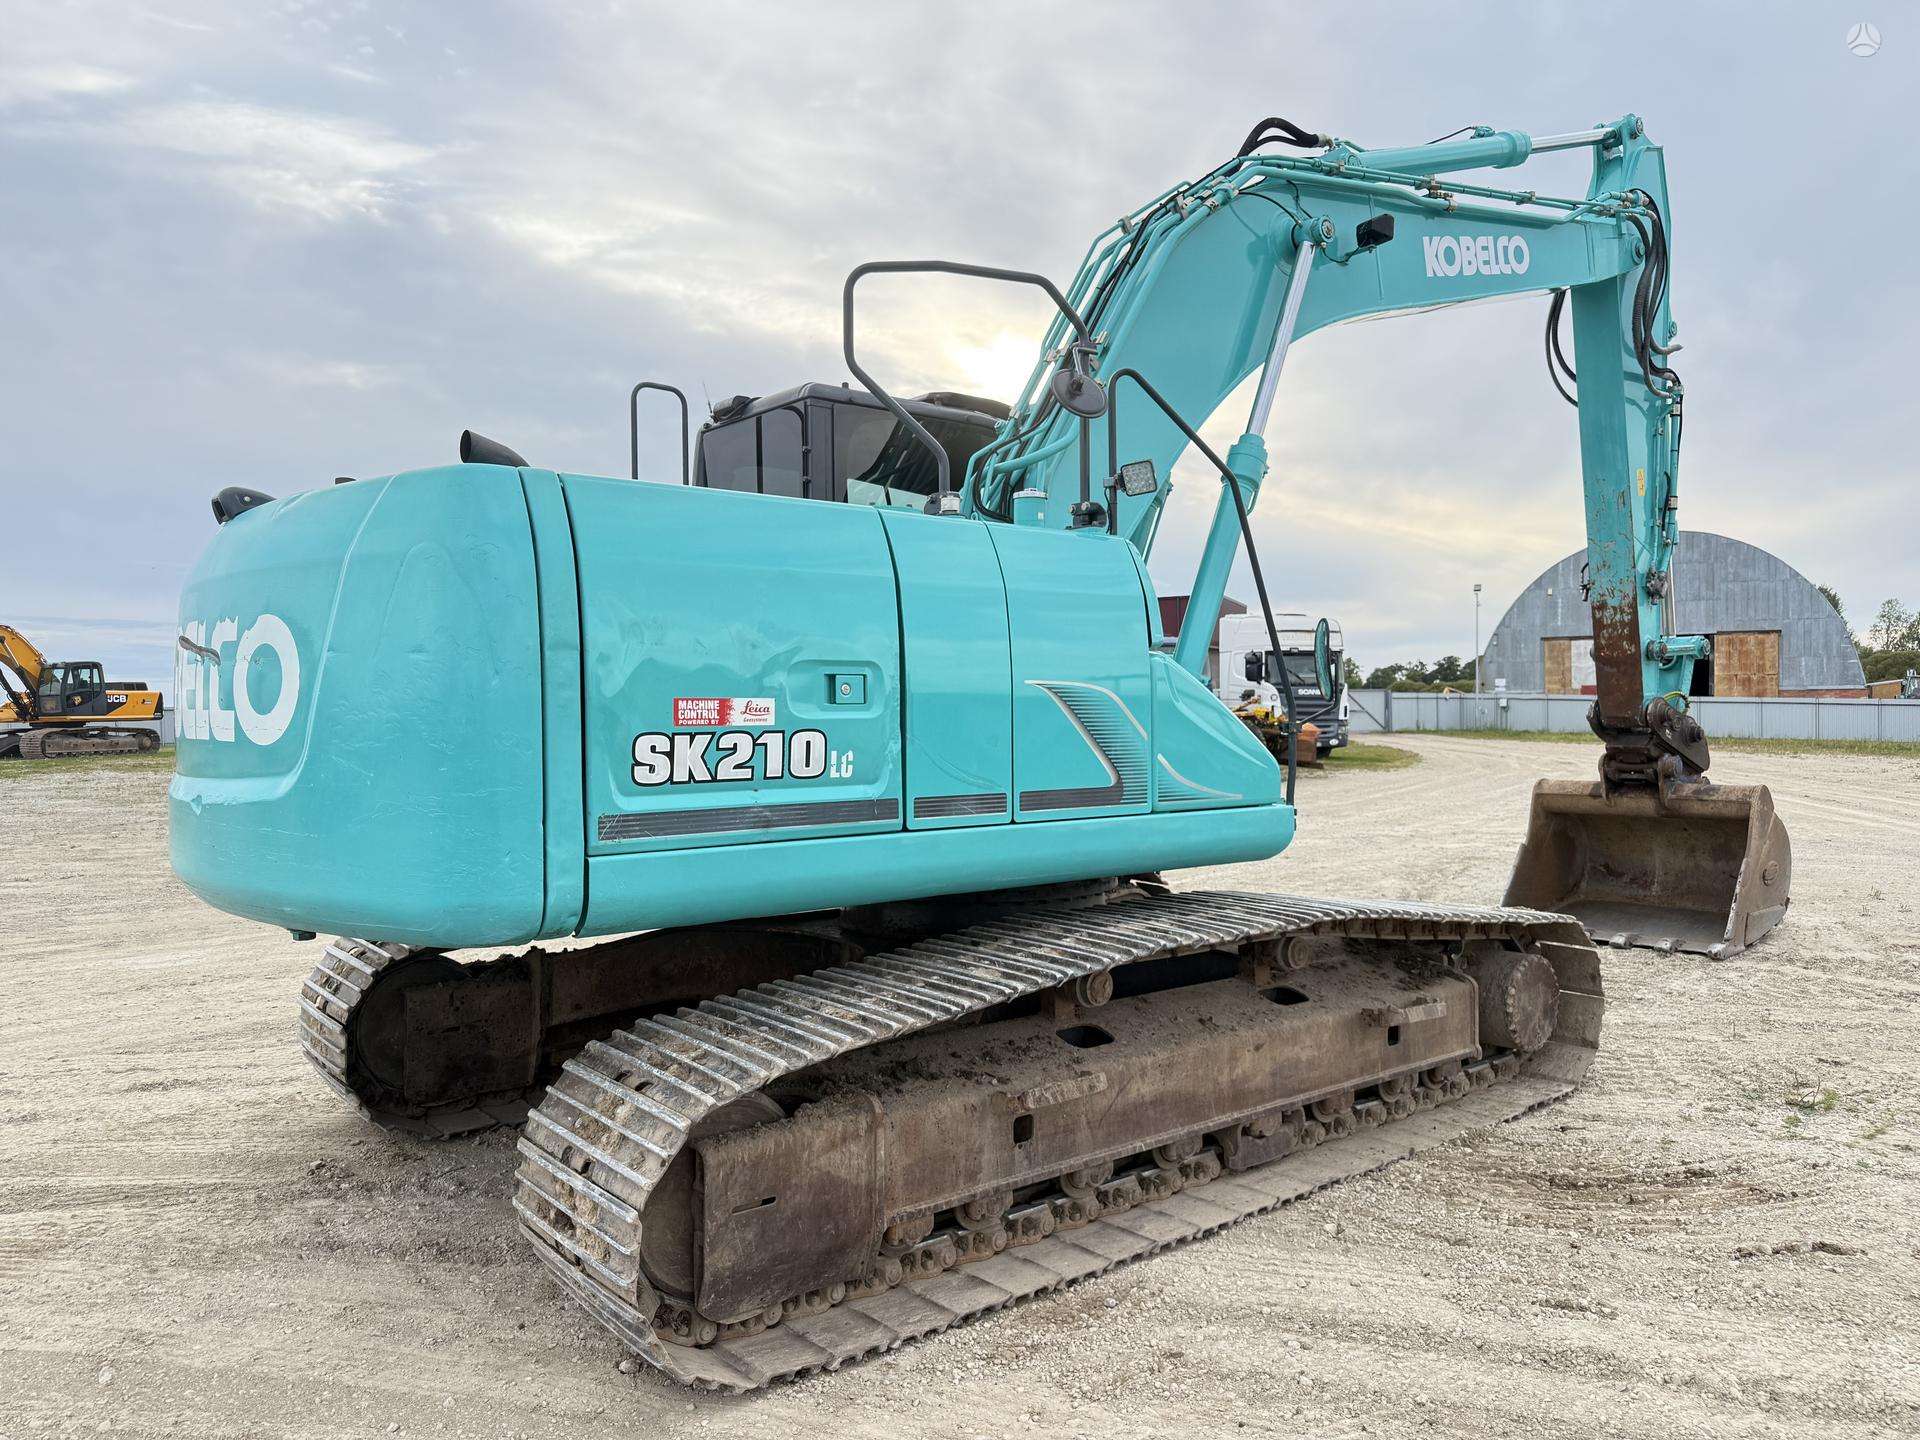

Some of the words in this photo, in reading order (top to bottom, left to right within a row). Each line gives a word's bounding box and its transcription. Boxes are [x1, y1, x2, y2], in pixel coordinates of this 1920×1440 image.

[1422, 234, 1530, 277] KOBELCO
[174, 613, 300, 746] ELCO
[107, 694, 127, 703] JCB
[678, 700, 720, 710] MACHINE
[678, 710, 720, 719] CONTROL
[740, 699, 771, 717] Leica
[632, 728, 827, 786] SK210
[829, 750, 855, 778] LC
